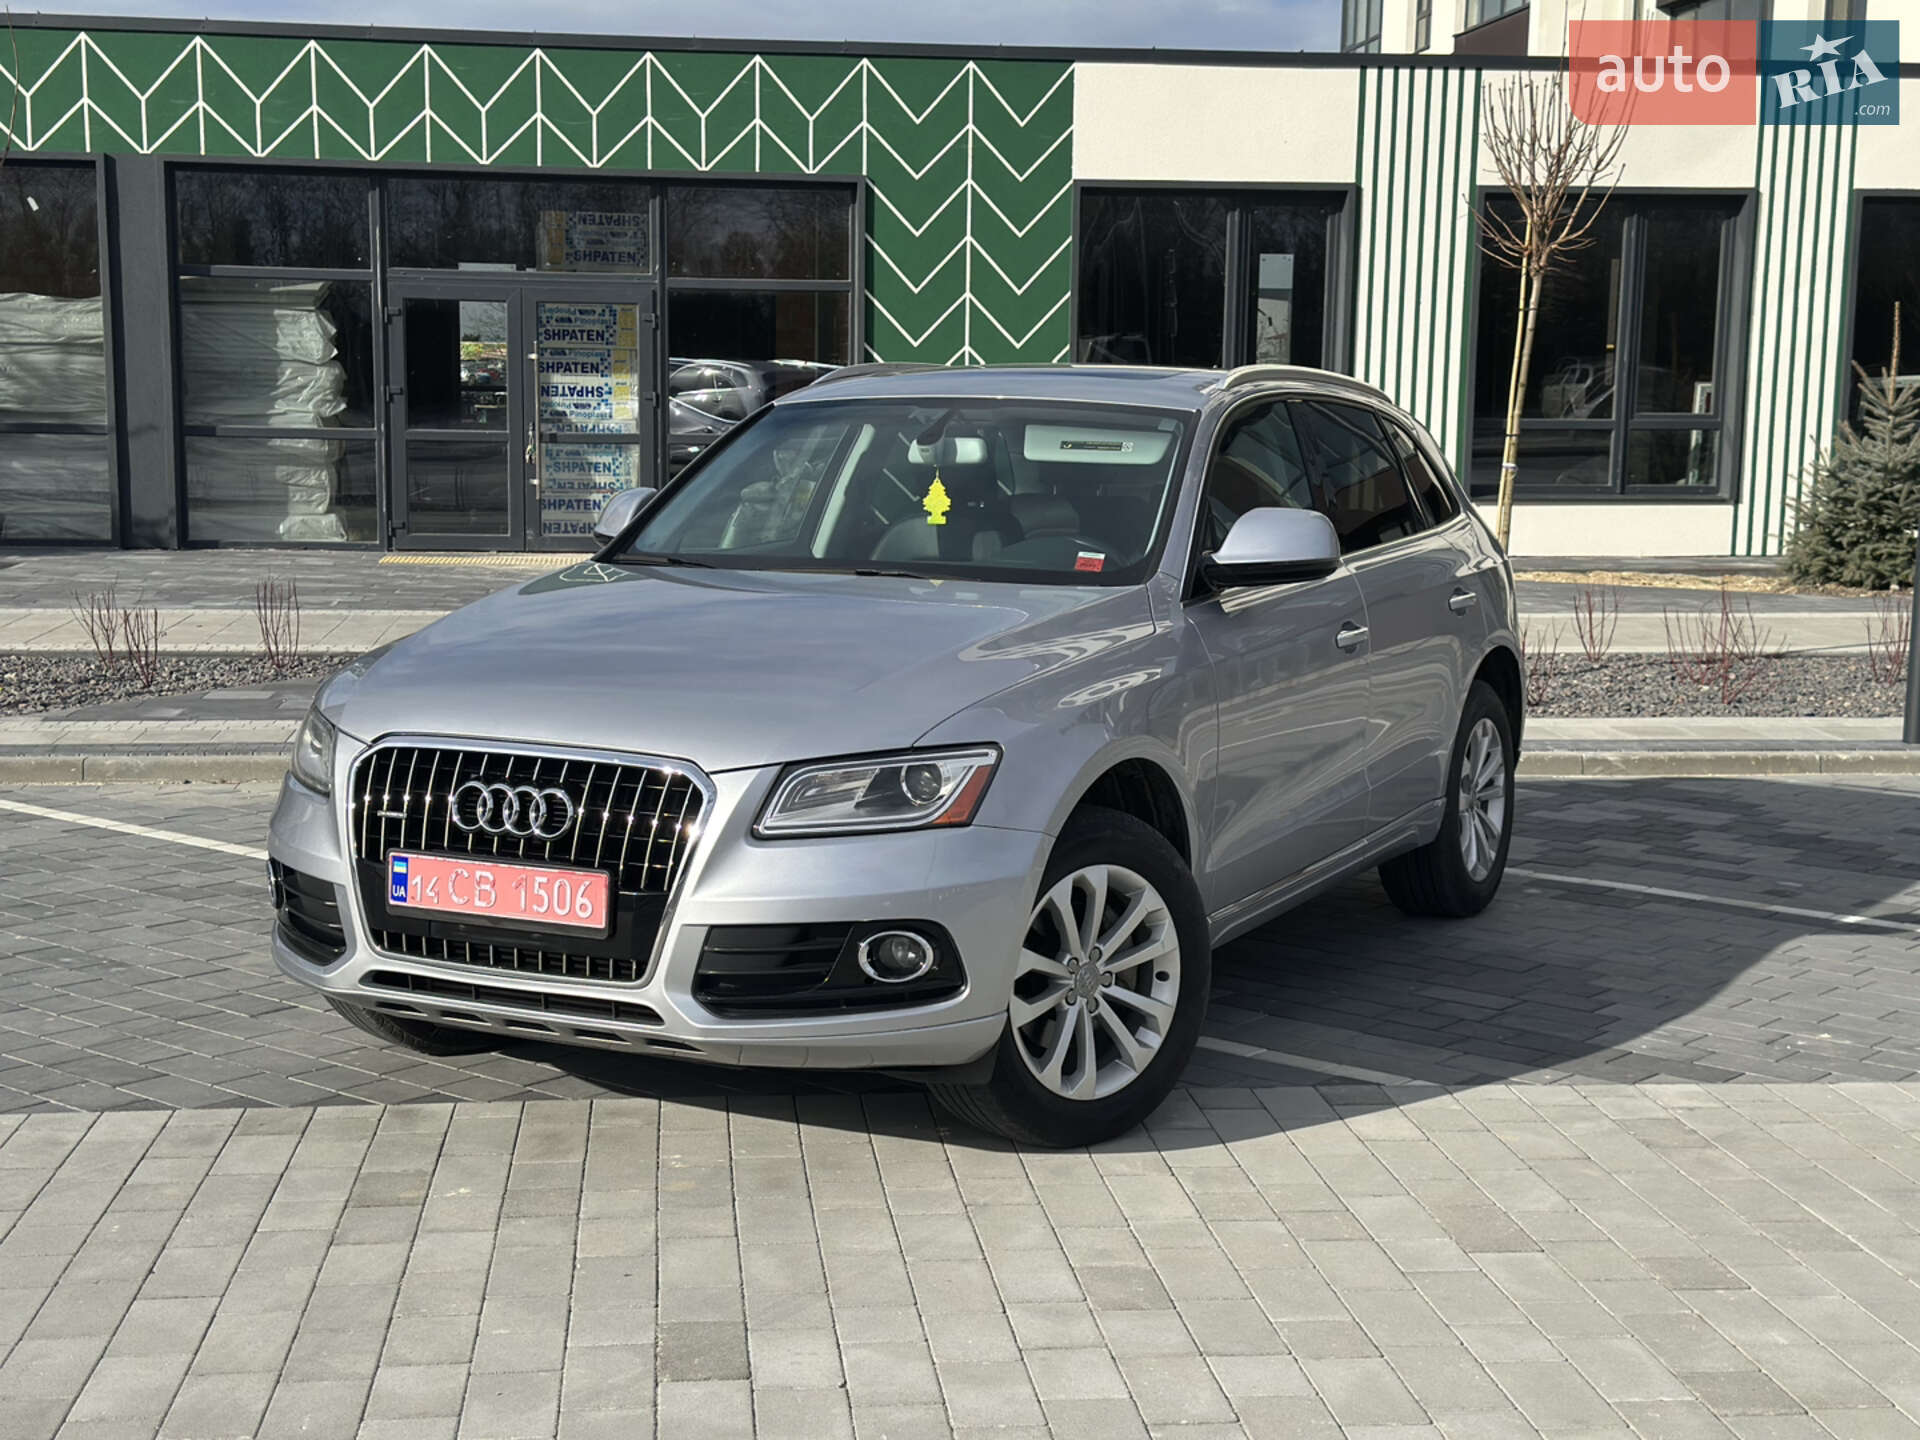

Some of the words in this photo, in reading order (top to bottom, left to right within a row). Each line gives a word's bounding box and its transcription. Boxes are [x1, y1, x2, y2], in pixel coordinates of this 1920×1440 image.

[577, 214, 641, 227] SHPATEN
[574, 250, 638, 263] SHPATEN
[543, 328, 605, 341] SHPATEN
[538, 361, 600, 374] SHPATEN
[541, 384, 604, 398] SHPATEN
[553, 461, 612, 473] SHPATEN
[543, 521, 597, 535] HPATEN
[392, 884, 407, 898] UA
[411, 874, 440, 905] 14
[447, 868, 497, 909] CB
[512, 873, 593, 919] 1506
